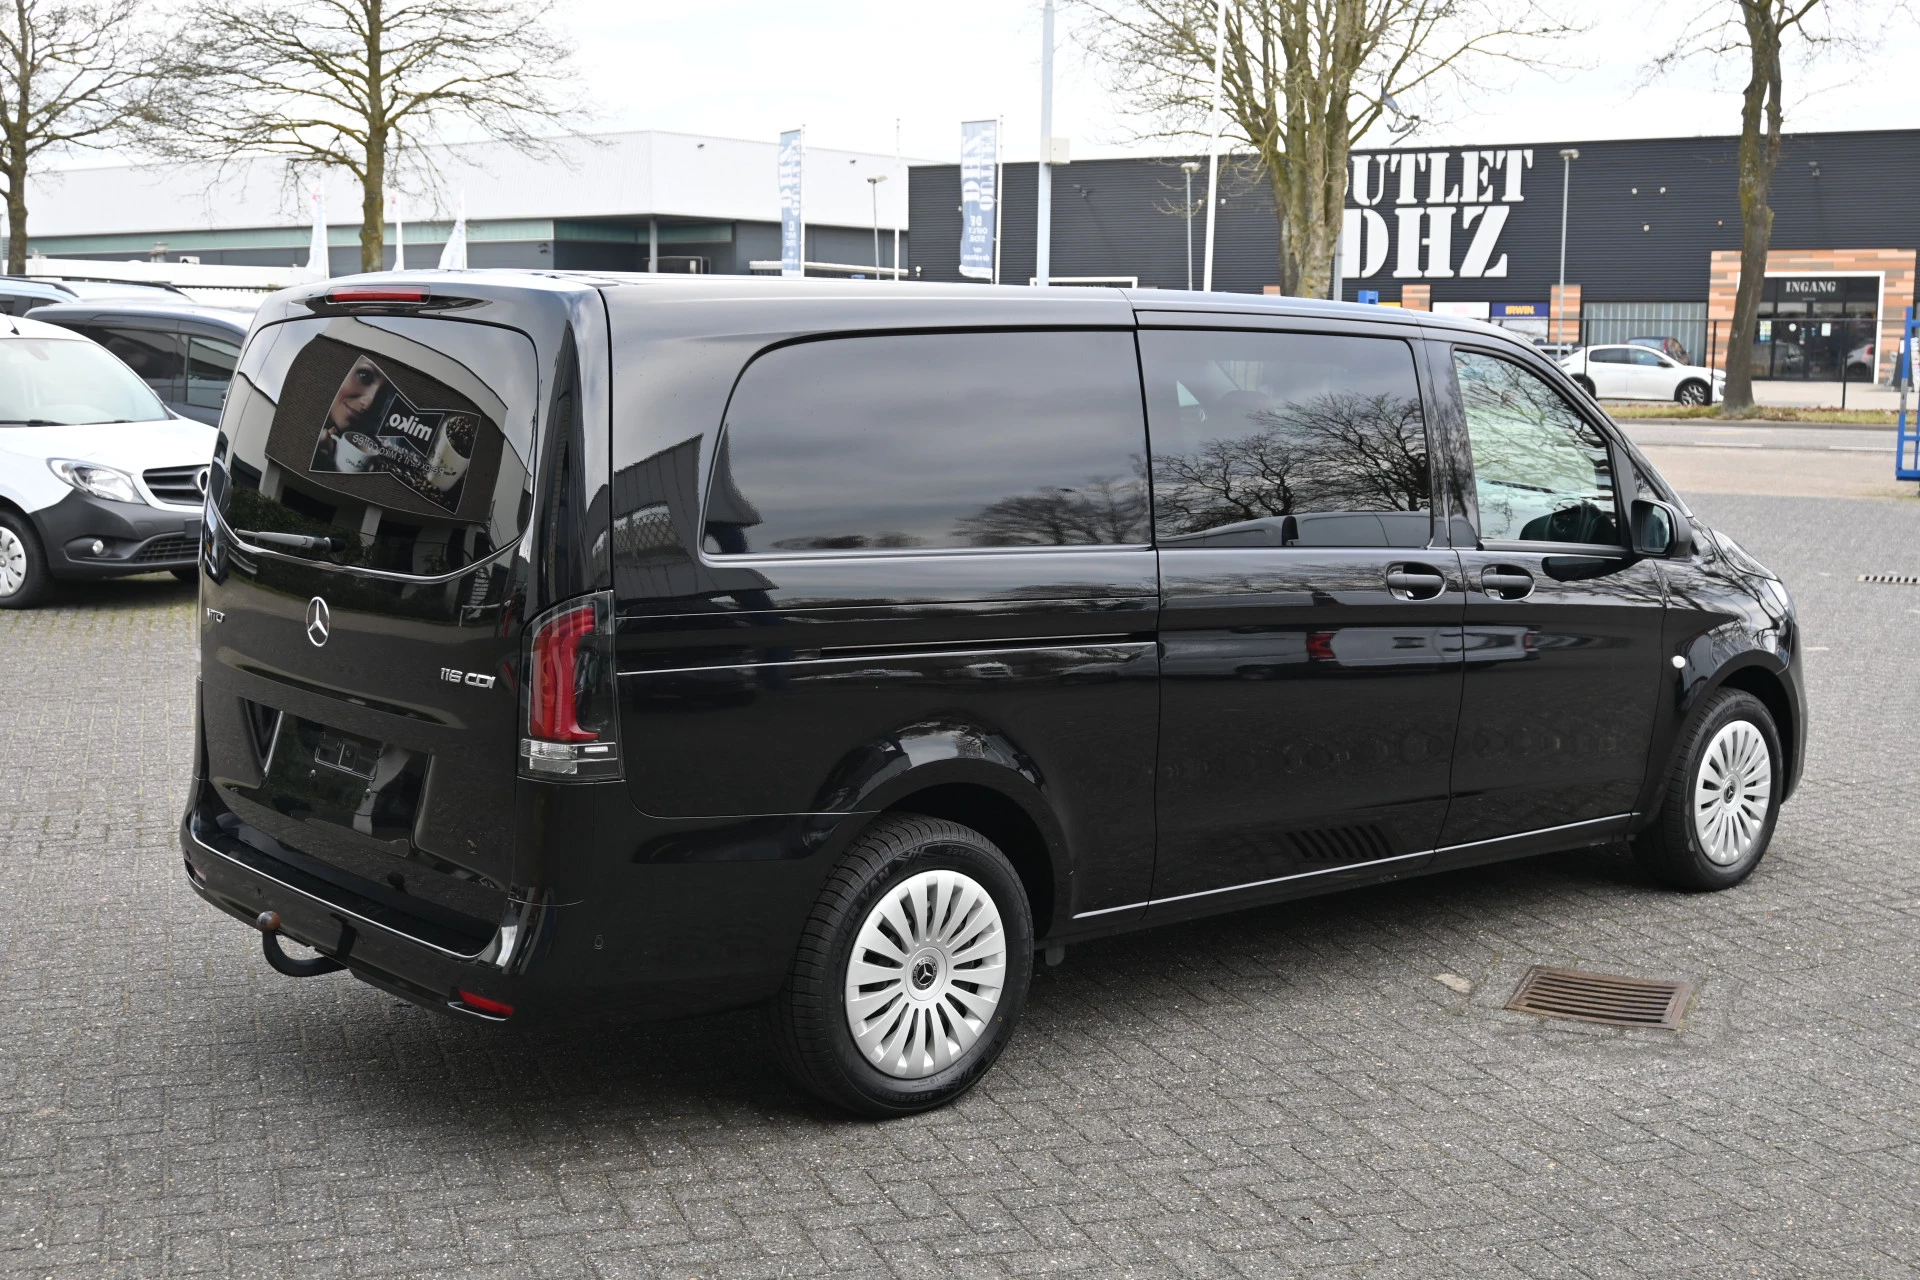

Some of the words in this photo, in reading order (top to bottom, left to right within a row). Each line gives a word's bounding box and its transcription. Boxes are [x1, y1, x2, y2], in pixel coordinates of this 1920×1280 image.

[1344, 149, 1533, 206] UTLET
[1341, 205, 1510, 279] DHZ
[1785, 281, 1836, 293] INGANG
[440, 667, 463, 683] 116
[464, 672, 497, 689] CDI
